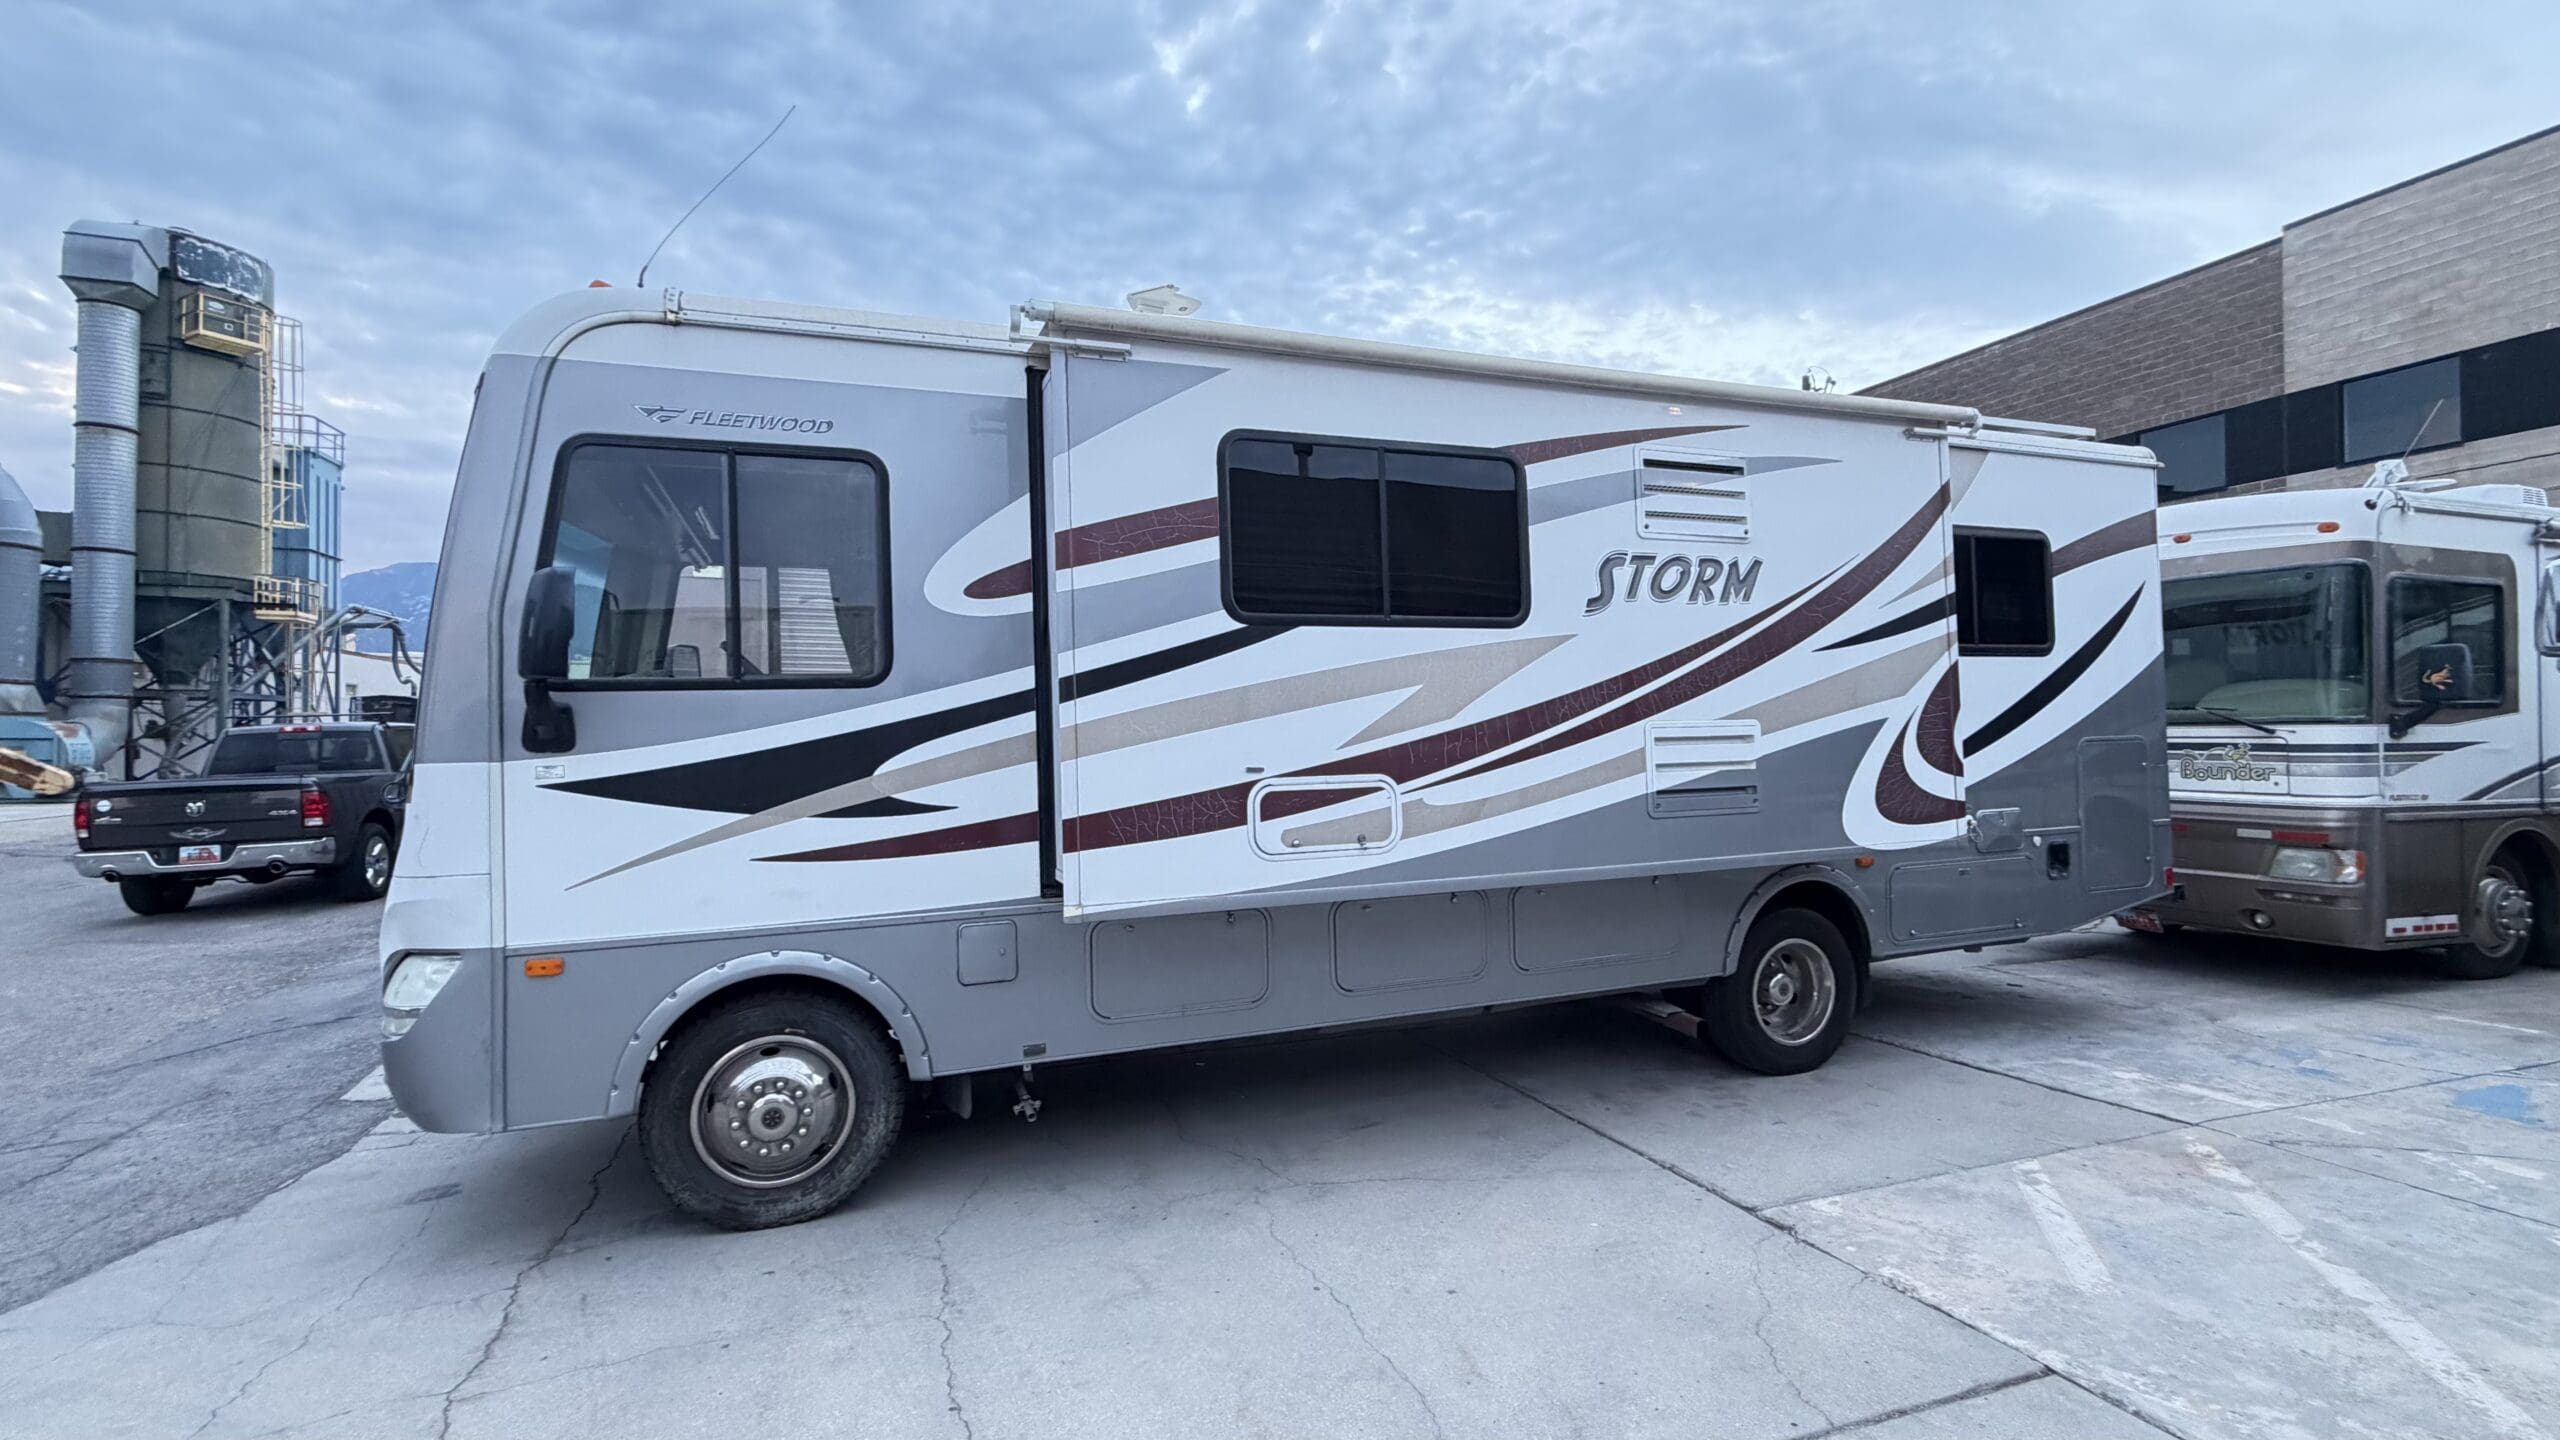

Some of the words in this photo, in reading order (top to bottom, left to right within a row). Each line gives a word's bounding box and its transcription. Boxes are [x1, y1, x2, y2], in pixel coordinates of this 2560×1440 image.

[688, 410, 834, 434] FLEETWOOD
[1582, 550, 1764, 617] STORM
[2181, 757, 2276, 781] Bounder
